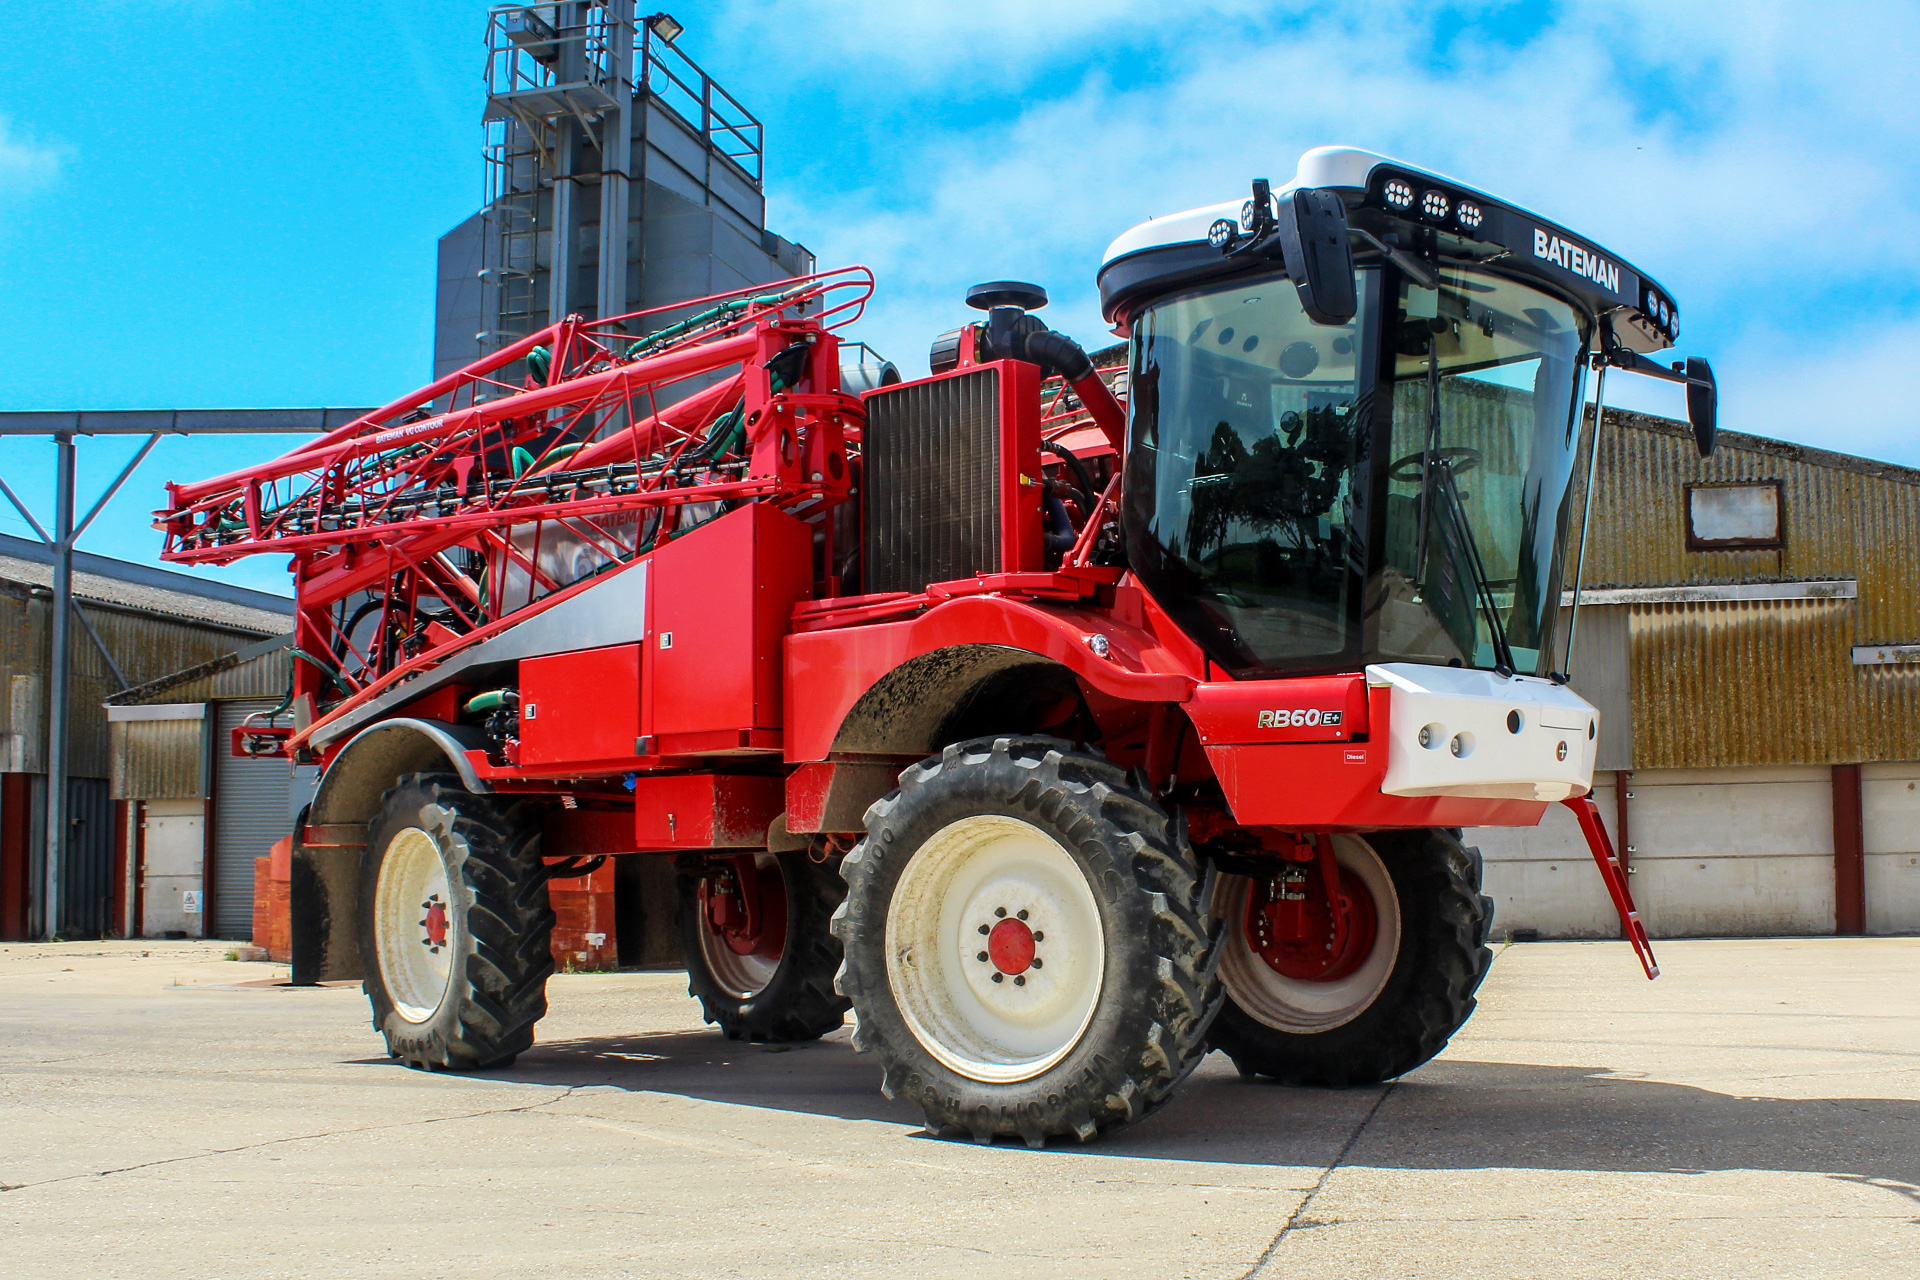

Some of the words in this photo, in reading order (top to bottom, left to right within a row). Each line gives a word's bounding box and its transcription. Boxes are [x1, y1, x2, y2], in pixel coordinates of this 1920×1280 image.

[1533, 228, 1619, 294] BATEMAN
[376, 430, 404, 443] BATEMAN
[406, 426, 414, 435] VG
[415, 419, 443, 433] CONTOUR
[1006, 778, 1127, 903] Mitas
